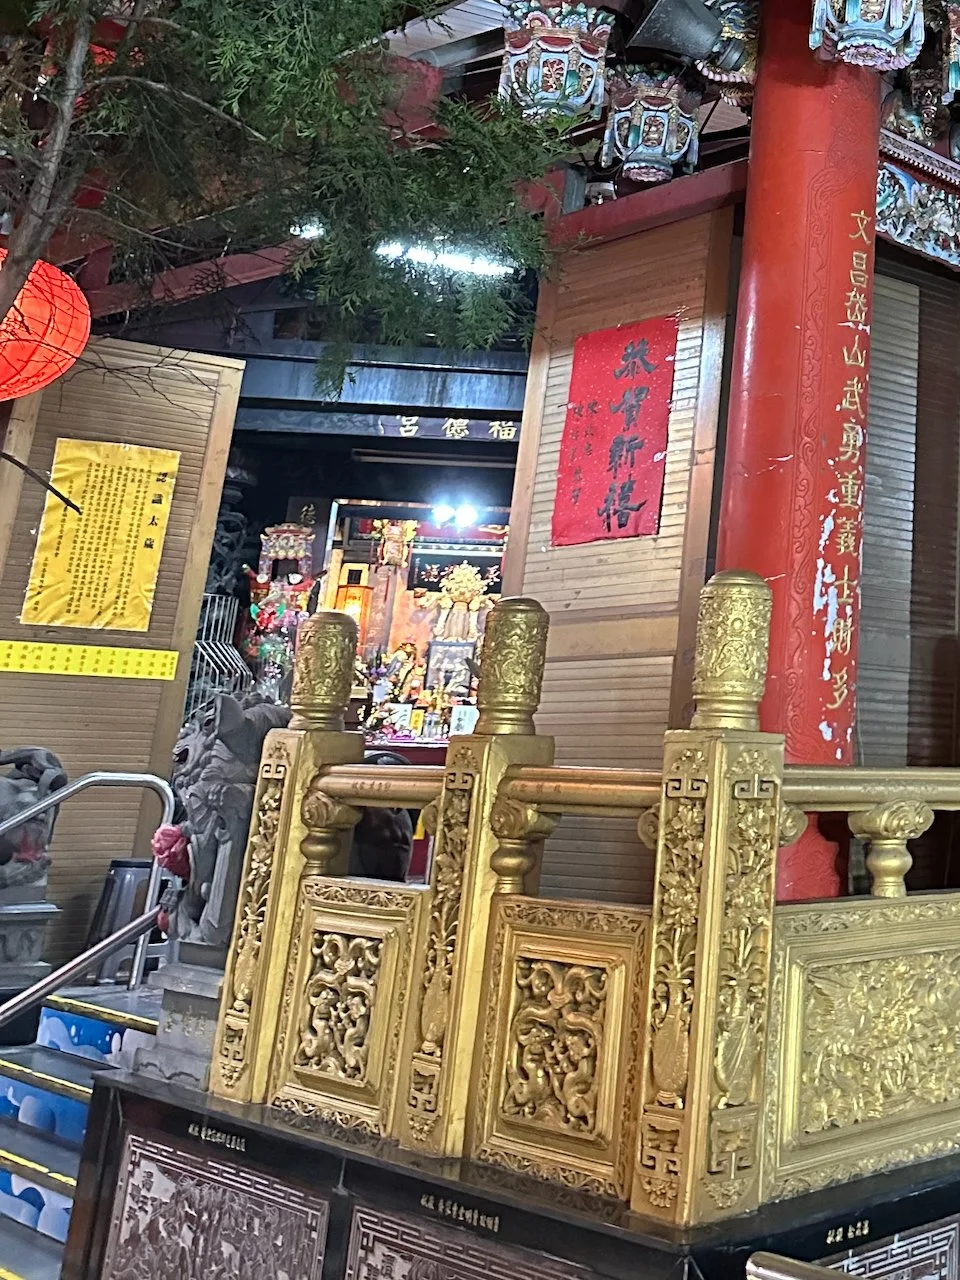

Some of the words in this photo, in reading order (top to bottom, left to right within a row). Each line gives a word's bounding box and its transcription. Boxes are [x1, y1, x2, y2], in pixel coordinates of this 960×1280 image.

[597, 337, 657, 533] 恭賀新禧
[143, 471, 168, 550] 認識太歲
